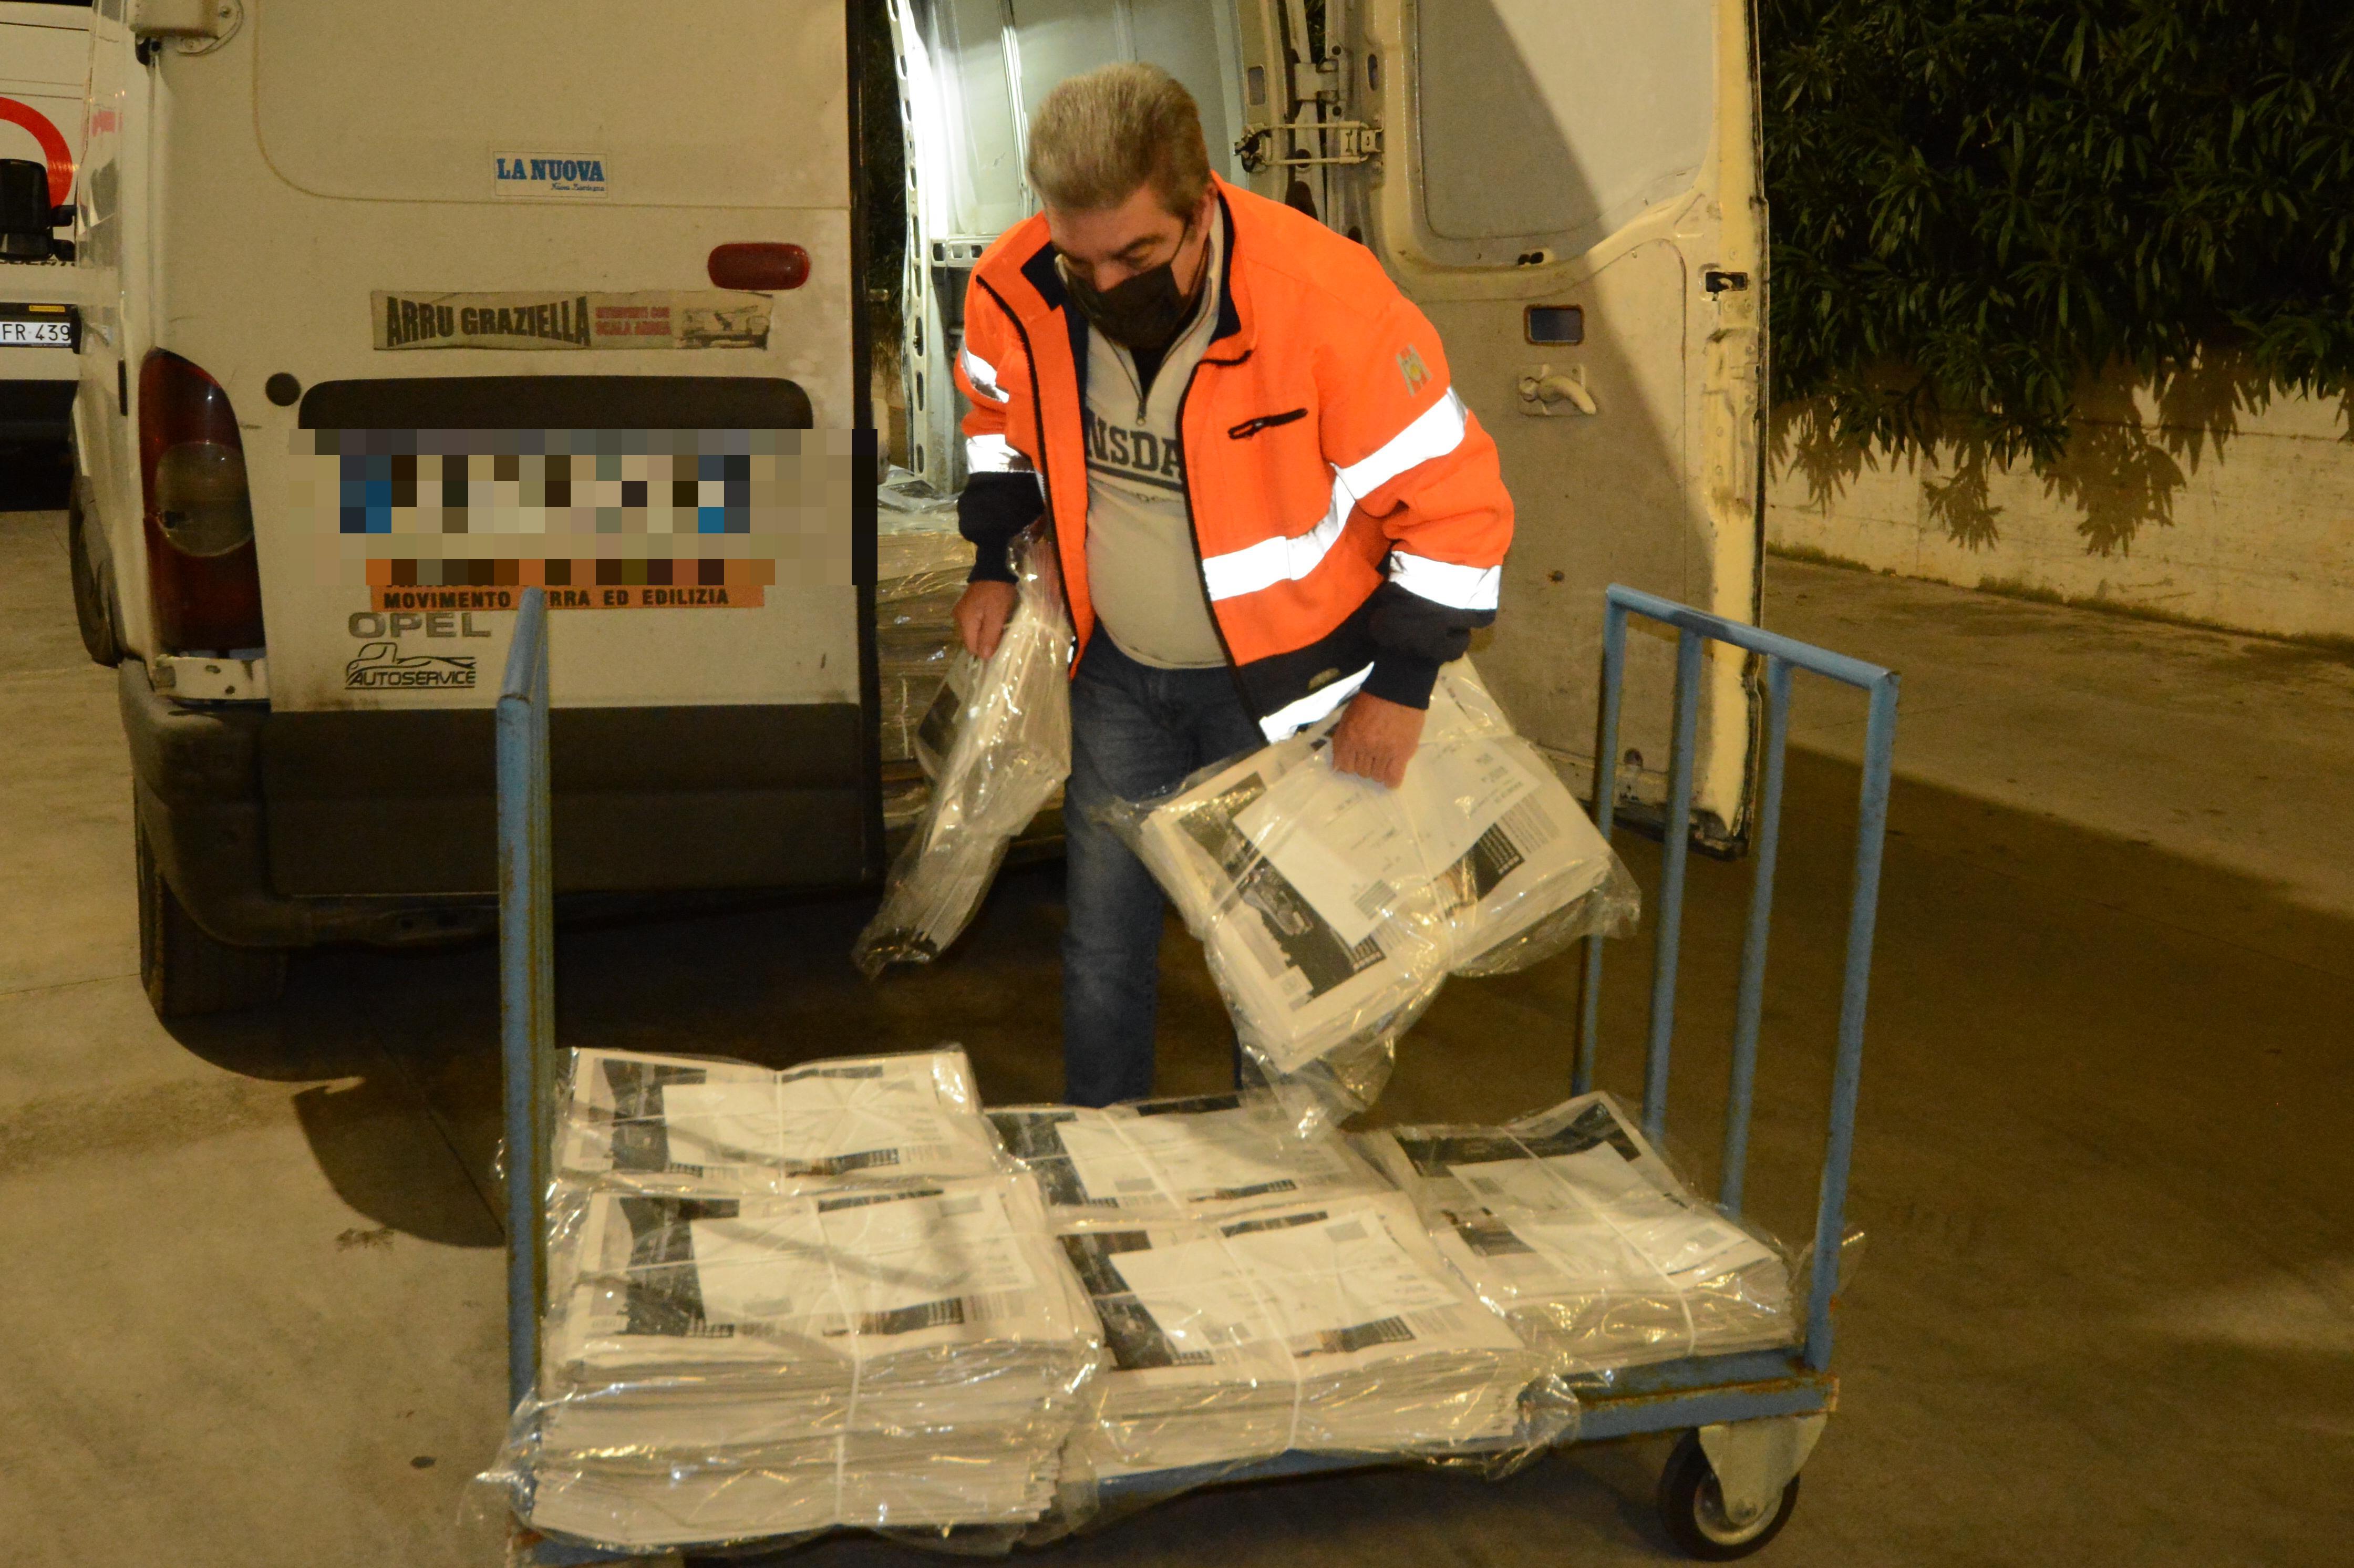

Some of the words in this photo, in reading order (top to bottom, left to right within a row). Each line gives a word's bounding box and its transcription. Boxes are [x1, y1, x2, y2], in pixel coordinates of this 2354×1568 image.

[497, 158, 526, 180] LA
[531, 159, 605, 182] NUOVA
[3, 324, 26, 341] FR
[35, 324, 70, 341] 439
[387, 296, 454, 347] ARRU
[460, 295, 592, 347] GRAZIELLA
[1087, 416, 1184, 477] NSDA
[384, 591, 511, 609] MOVIMENTO
[549, 590, 591, 607] RRA
[603, 589, 629, 606] ED
[642, 588, 729, 605] EDILIZIA
[348, 612, 492, 638] OPEL
[347, 670, 477, 687] AUTOSERVICE
